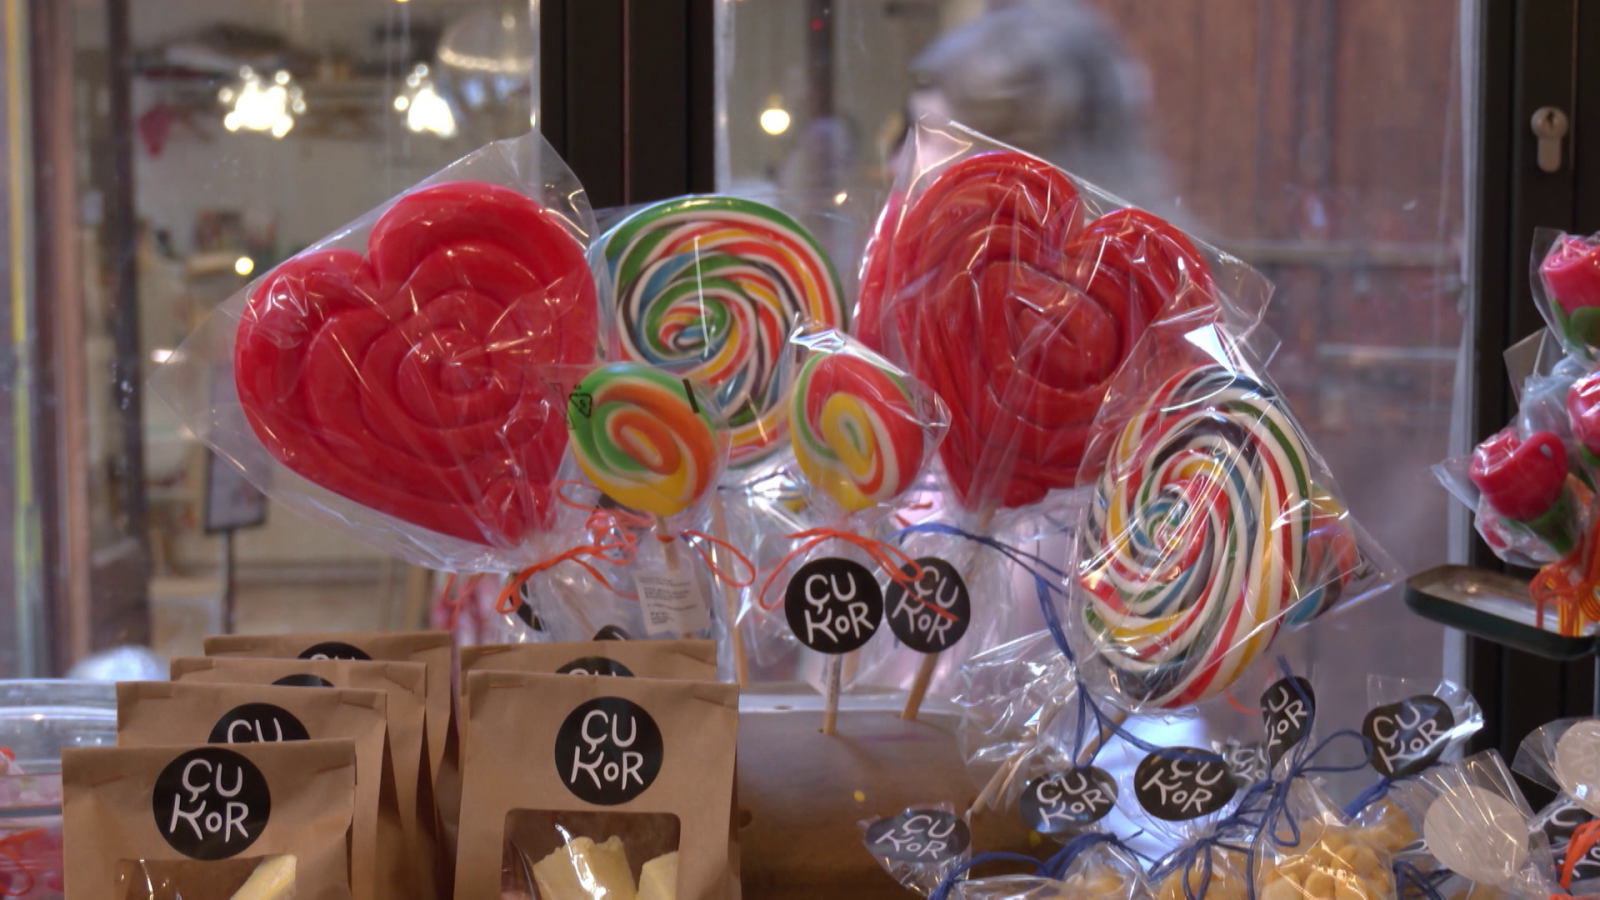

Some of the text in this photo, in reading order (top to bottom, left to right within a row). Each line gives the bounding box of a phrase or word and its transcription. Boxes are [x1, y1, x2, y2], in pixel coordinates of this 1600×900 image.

[804, 572, 857, 615] ÇU
[580, 709, 637, 755] ÇU
[181, 758, 244, 803] ÇU
[902, 814, 956, 839] ÇU
